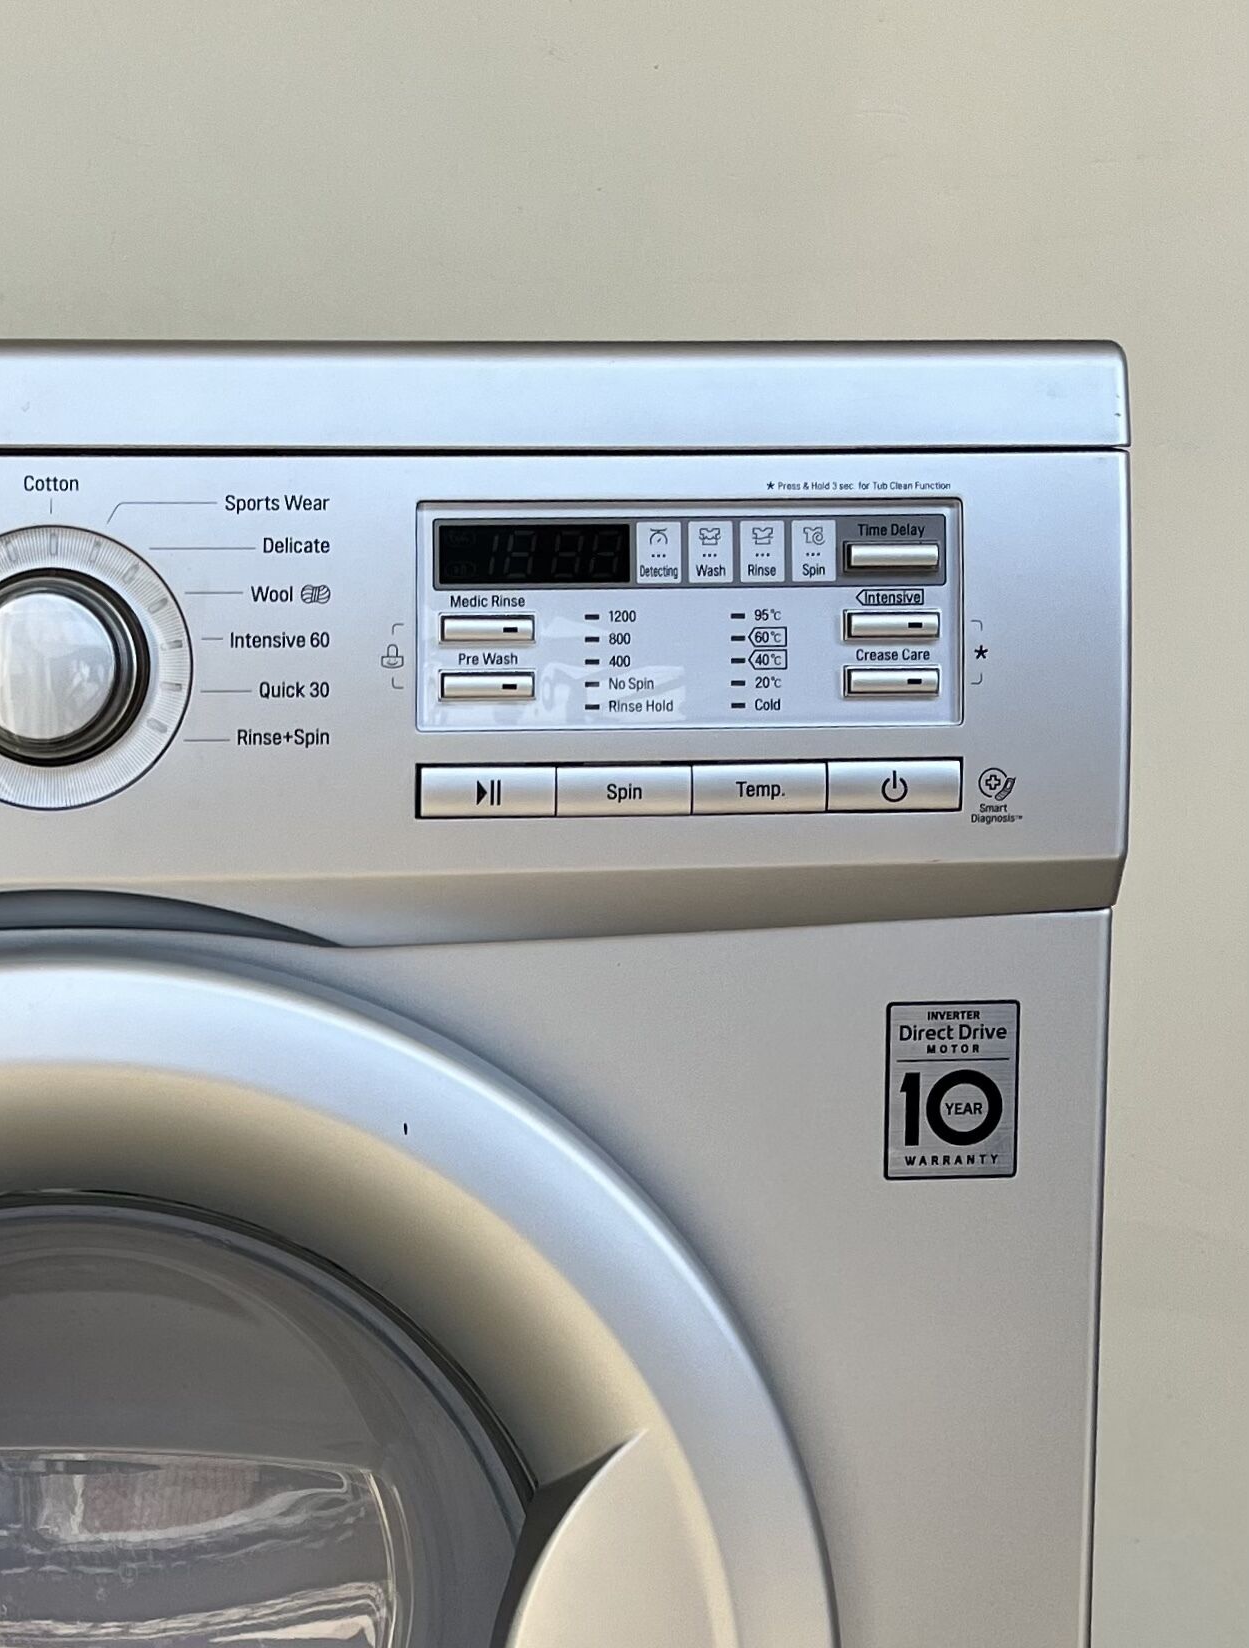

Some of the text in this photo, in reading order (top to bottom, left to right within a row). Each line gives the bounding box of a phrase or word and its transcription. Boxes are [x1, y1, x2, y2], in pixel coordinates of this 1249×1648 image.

[23, 475, 79, 492] Cotton
[777, 482, 801, 491] Press
[802, 482, 810, 491] &
[811, 482, 831, 491] Hold
[831, 482, 838, 491] 3
[858, 482, 871, 491] for
[872, 482, 888, 491] Tub
[889, 482, 914, 491] Clean
[914, 481, 951, 491] Function
[226, 495, 331, 514] Sports Wear
[857, 523, 926, 539] Time Delay
[263, 537, 331, 554] Delicate
[639, 565, 679, 580] Detecting
[695, 565, 726, 577] Wash
[747, 564, 777, 577] Rinse
[802, 564, 826, 578] Spin
[250, 586, 294, 603] Wool
[864, 592, 920, 604] Intensive
[450, 595, 526, 608] Medic Rinse
[608, 610, 637, 623] 1200
[230, 632, 330, 649] Intensive 60
[608, 633, 631, 646] 800
[458, 653, 518, 666] Pre Wash
[608, 655, 631, 668] 400
[855, 649, 931, 662] Crease Care
[260, 682, 330, 699] Quick 30
[608, 677, 655, 692] No Spin
[608, 700, 674, 713] Rinse Hold
[754, 699, 781, 712] Cold
[238, 729, 329, 748] Rinse+Spin
[607, 784, 642, 803] Spin
[736, 781, 785, 800] Temp.
[979, 804, 1008, 814] Smart
[927, 1011, 981, 1021] INVERTER
[899, 1024, 1008, 1042] Direct Drive
[926, 1044, 980, 1055] MOTOR
[900, 1069, 1002, 1146] 10
[944, 1103, 983, 1116] YEAR
[904, 1154, 999, 1167] WARRANTY
